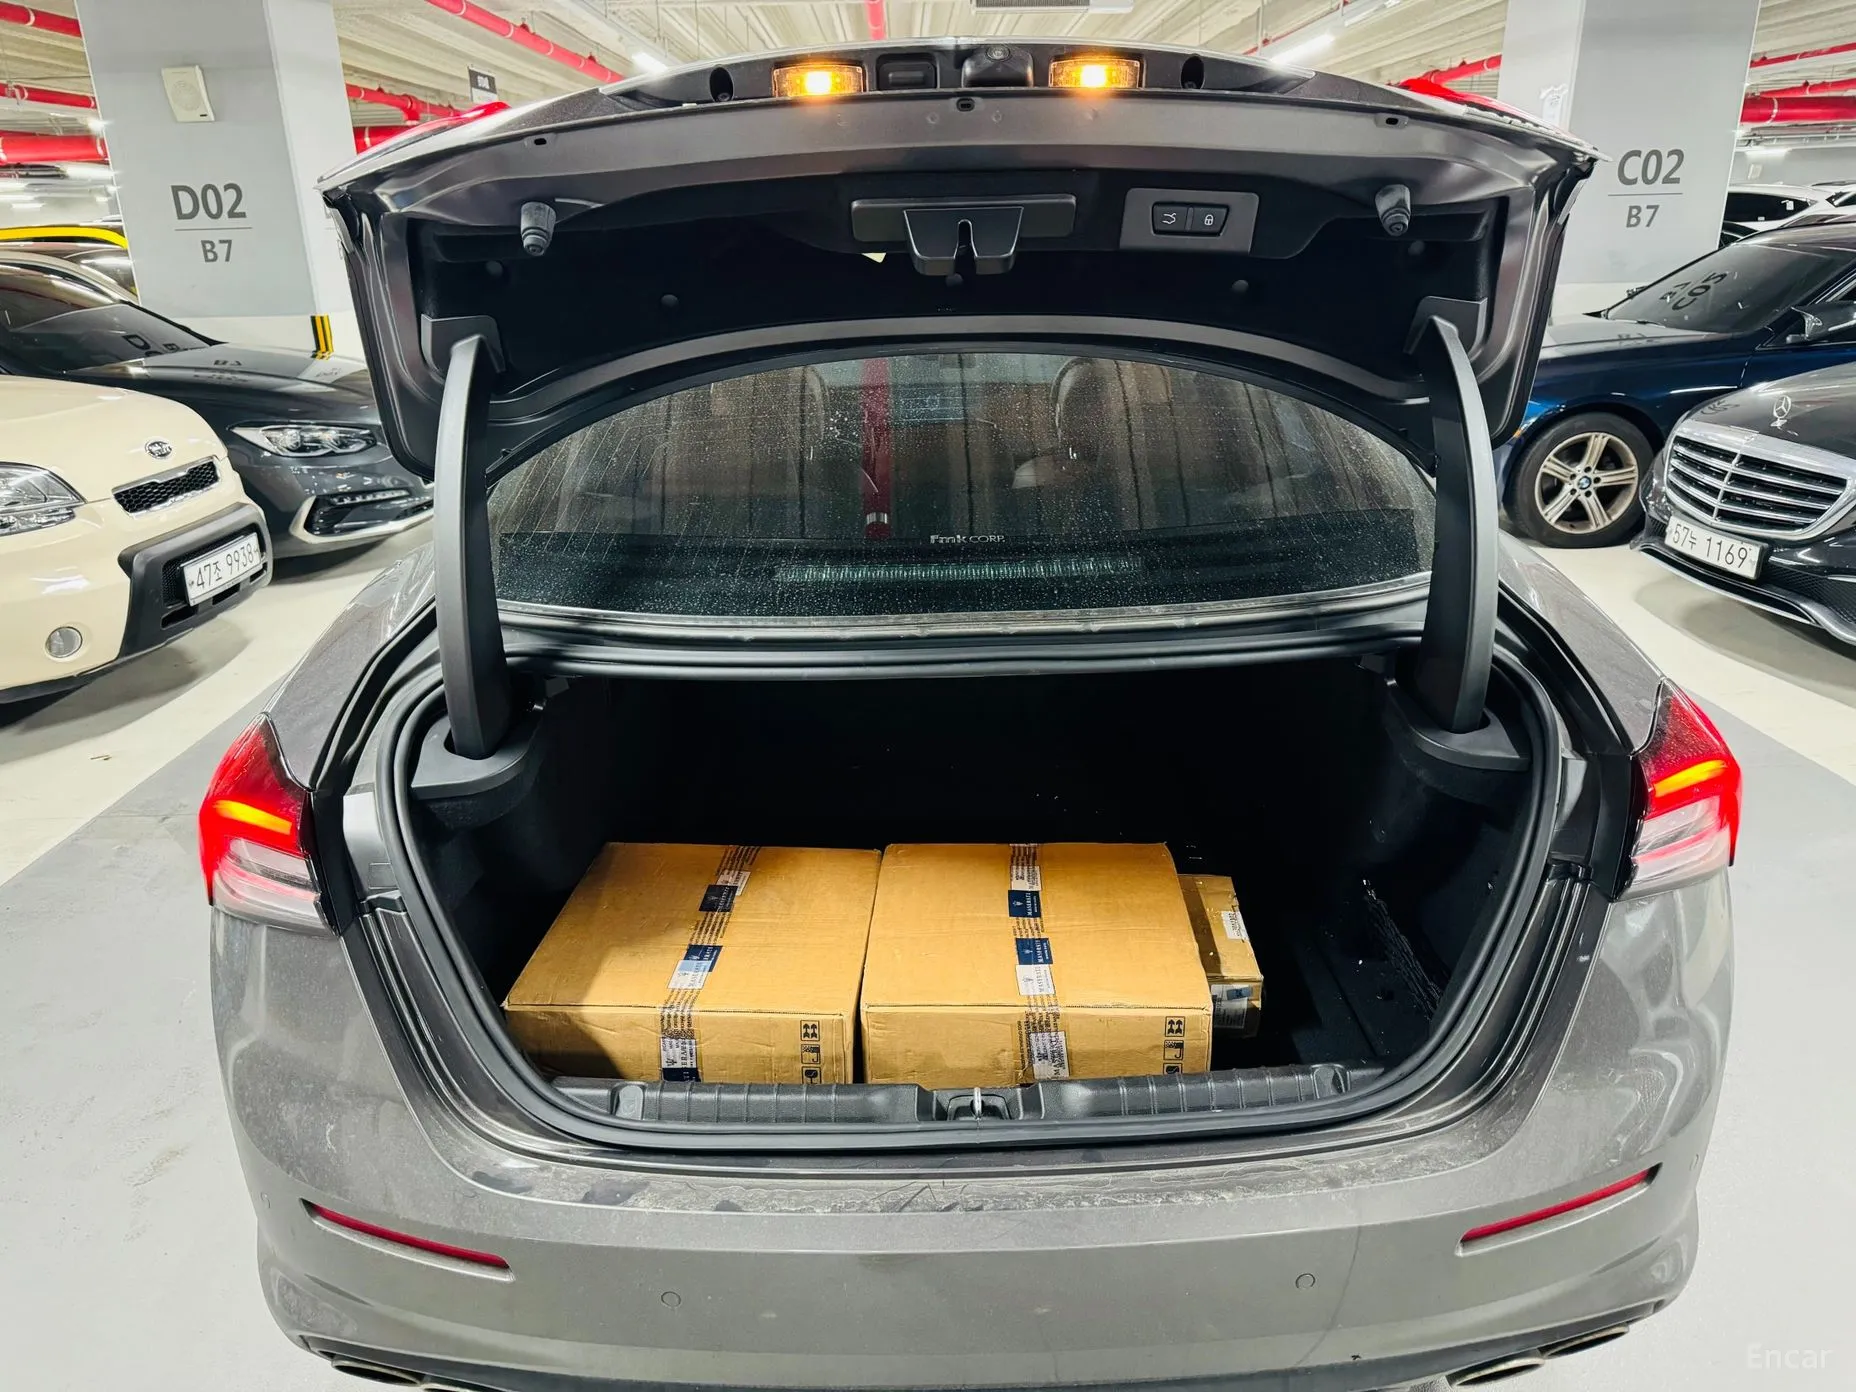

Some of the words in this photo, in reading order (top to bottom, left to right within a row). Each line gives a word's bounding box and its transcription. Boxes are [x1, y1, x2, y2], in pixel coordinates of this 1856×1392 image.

[1617, 149, 1684, 186] C02
[171, 183, 247, 220] D02
[1626, 205, 1660, 228] B7
[201, 239, 233, 263] B7
[1672, 523, 1697, 550] 57누
[1706, 536, 1748, 569] 1169
[195, 561, 223, 589] 47조
[225, 543, 255, 576] 9938
